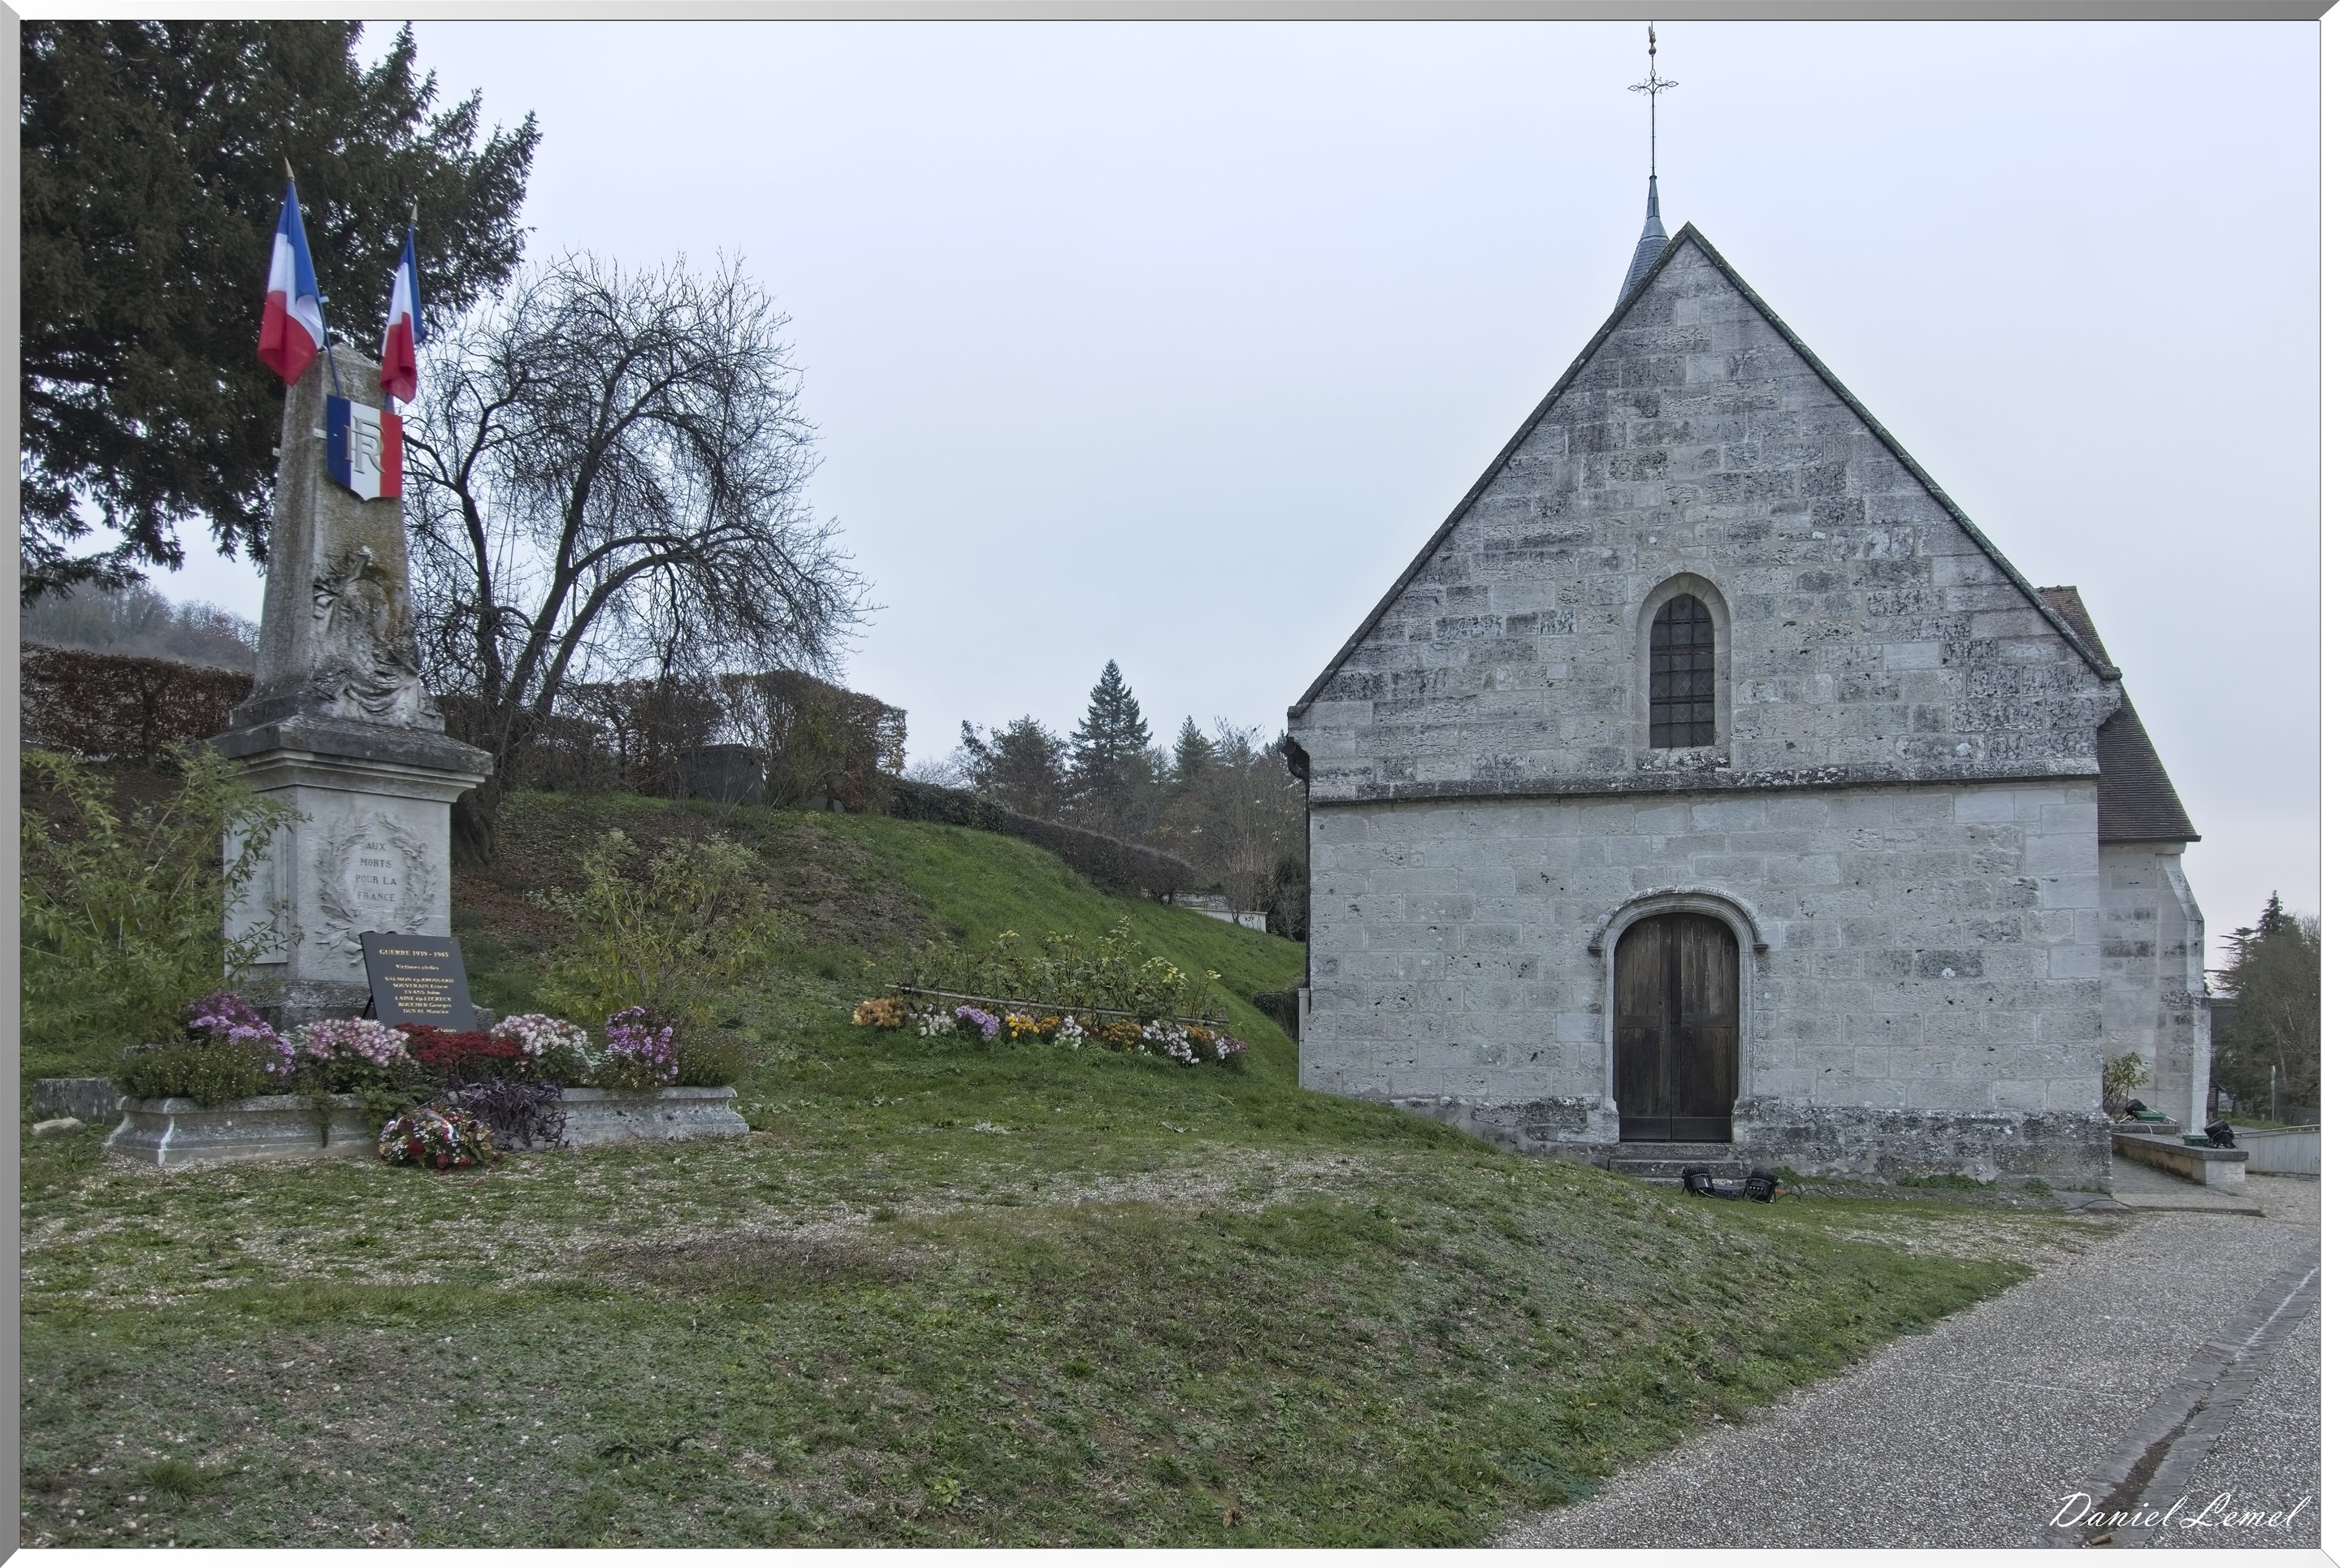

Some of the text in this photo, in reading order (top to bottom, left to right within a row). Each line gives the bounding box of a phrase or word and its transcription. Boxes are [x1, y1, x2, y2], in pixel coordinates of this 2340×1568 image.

[366, 842, 387, 851] AUX
[360, 859, 392, 868] MORTS
[356, 875, 396, 886] POUR LA
[358, 892, 396, 902] FRANCE
